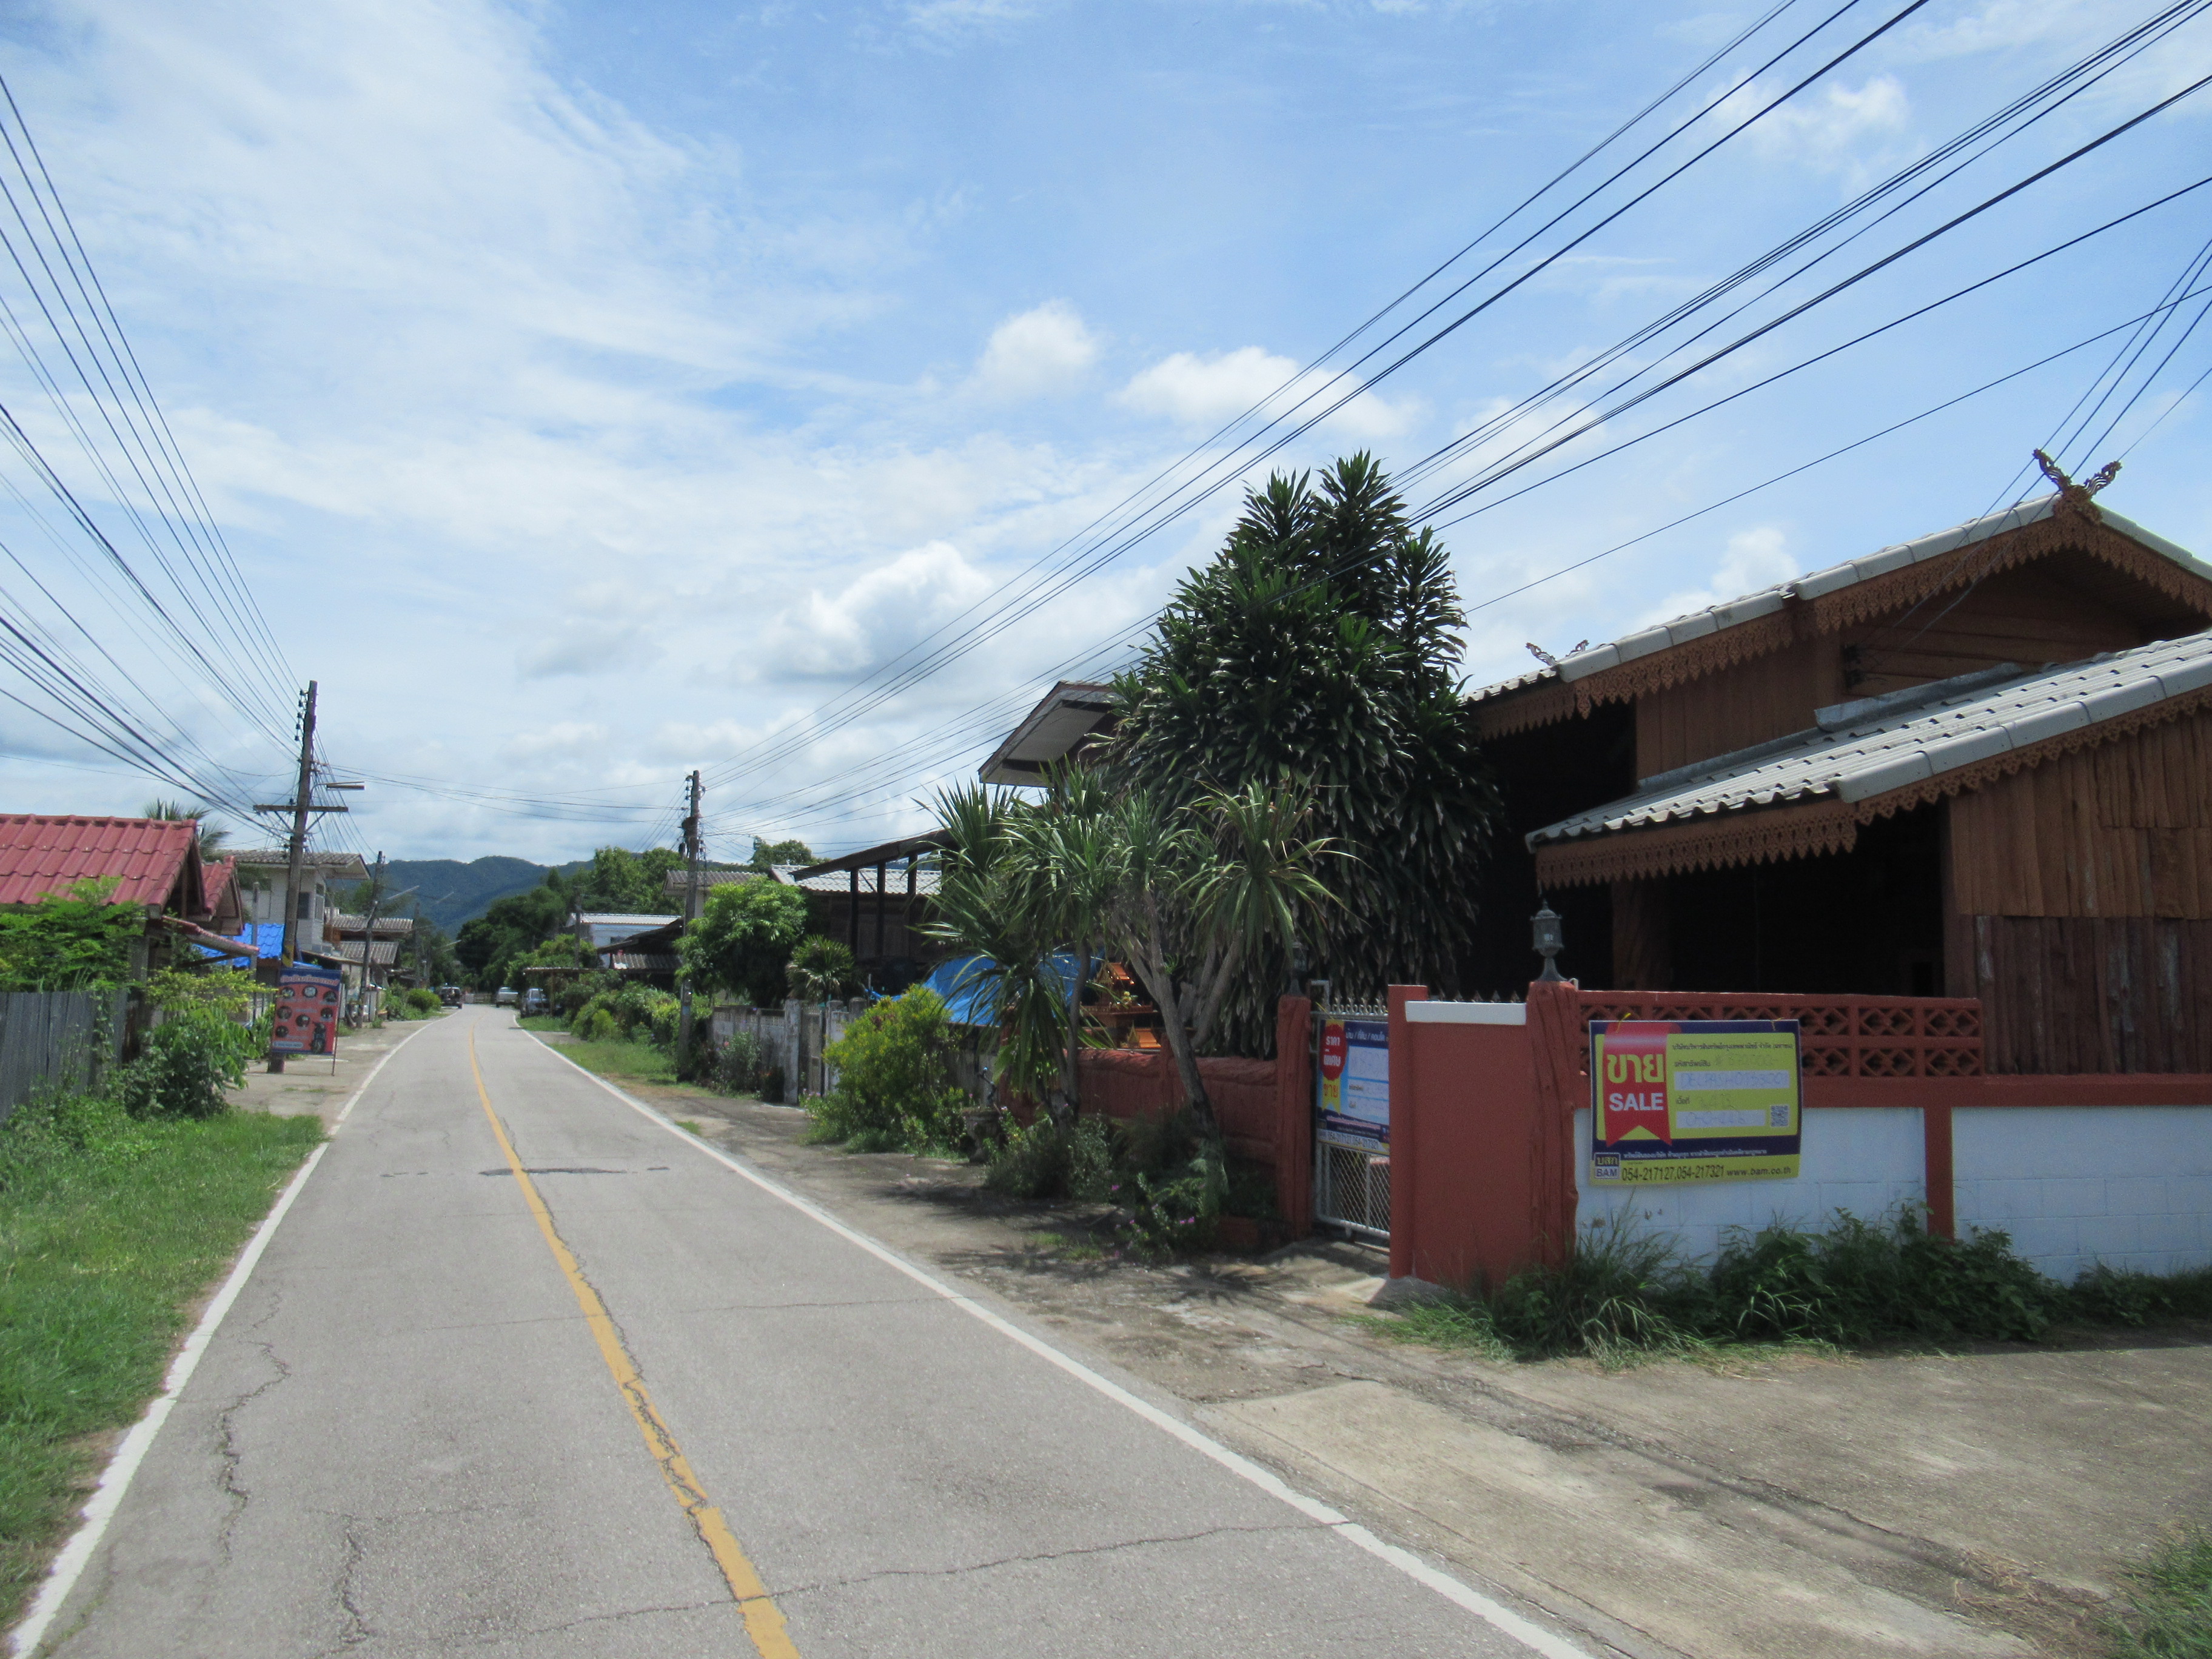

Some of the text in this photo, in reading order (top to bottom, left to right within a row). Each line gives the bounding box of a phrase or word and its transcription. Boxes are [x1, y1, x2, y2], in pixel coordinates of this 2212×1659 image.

[1326, 1036, 1341, 1047] ราคา
[1607, 1054, 1664, 1084] ขาย
[1609, 1093, 1664, 1111] SALE
[1596, 1168, 1618, 1178] BAM
